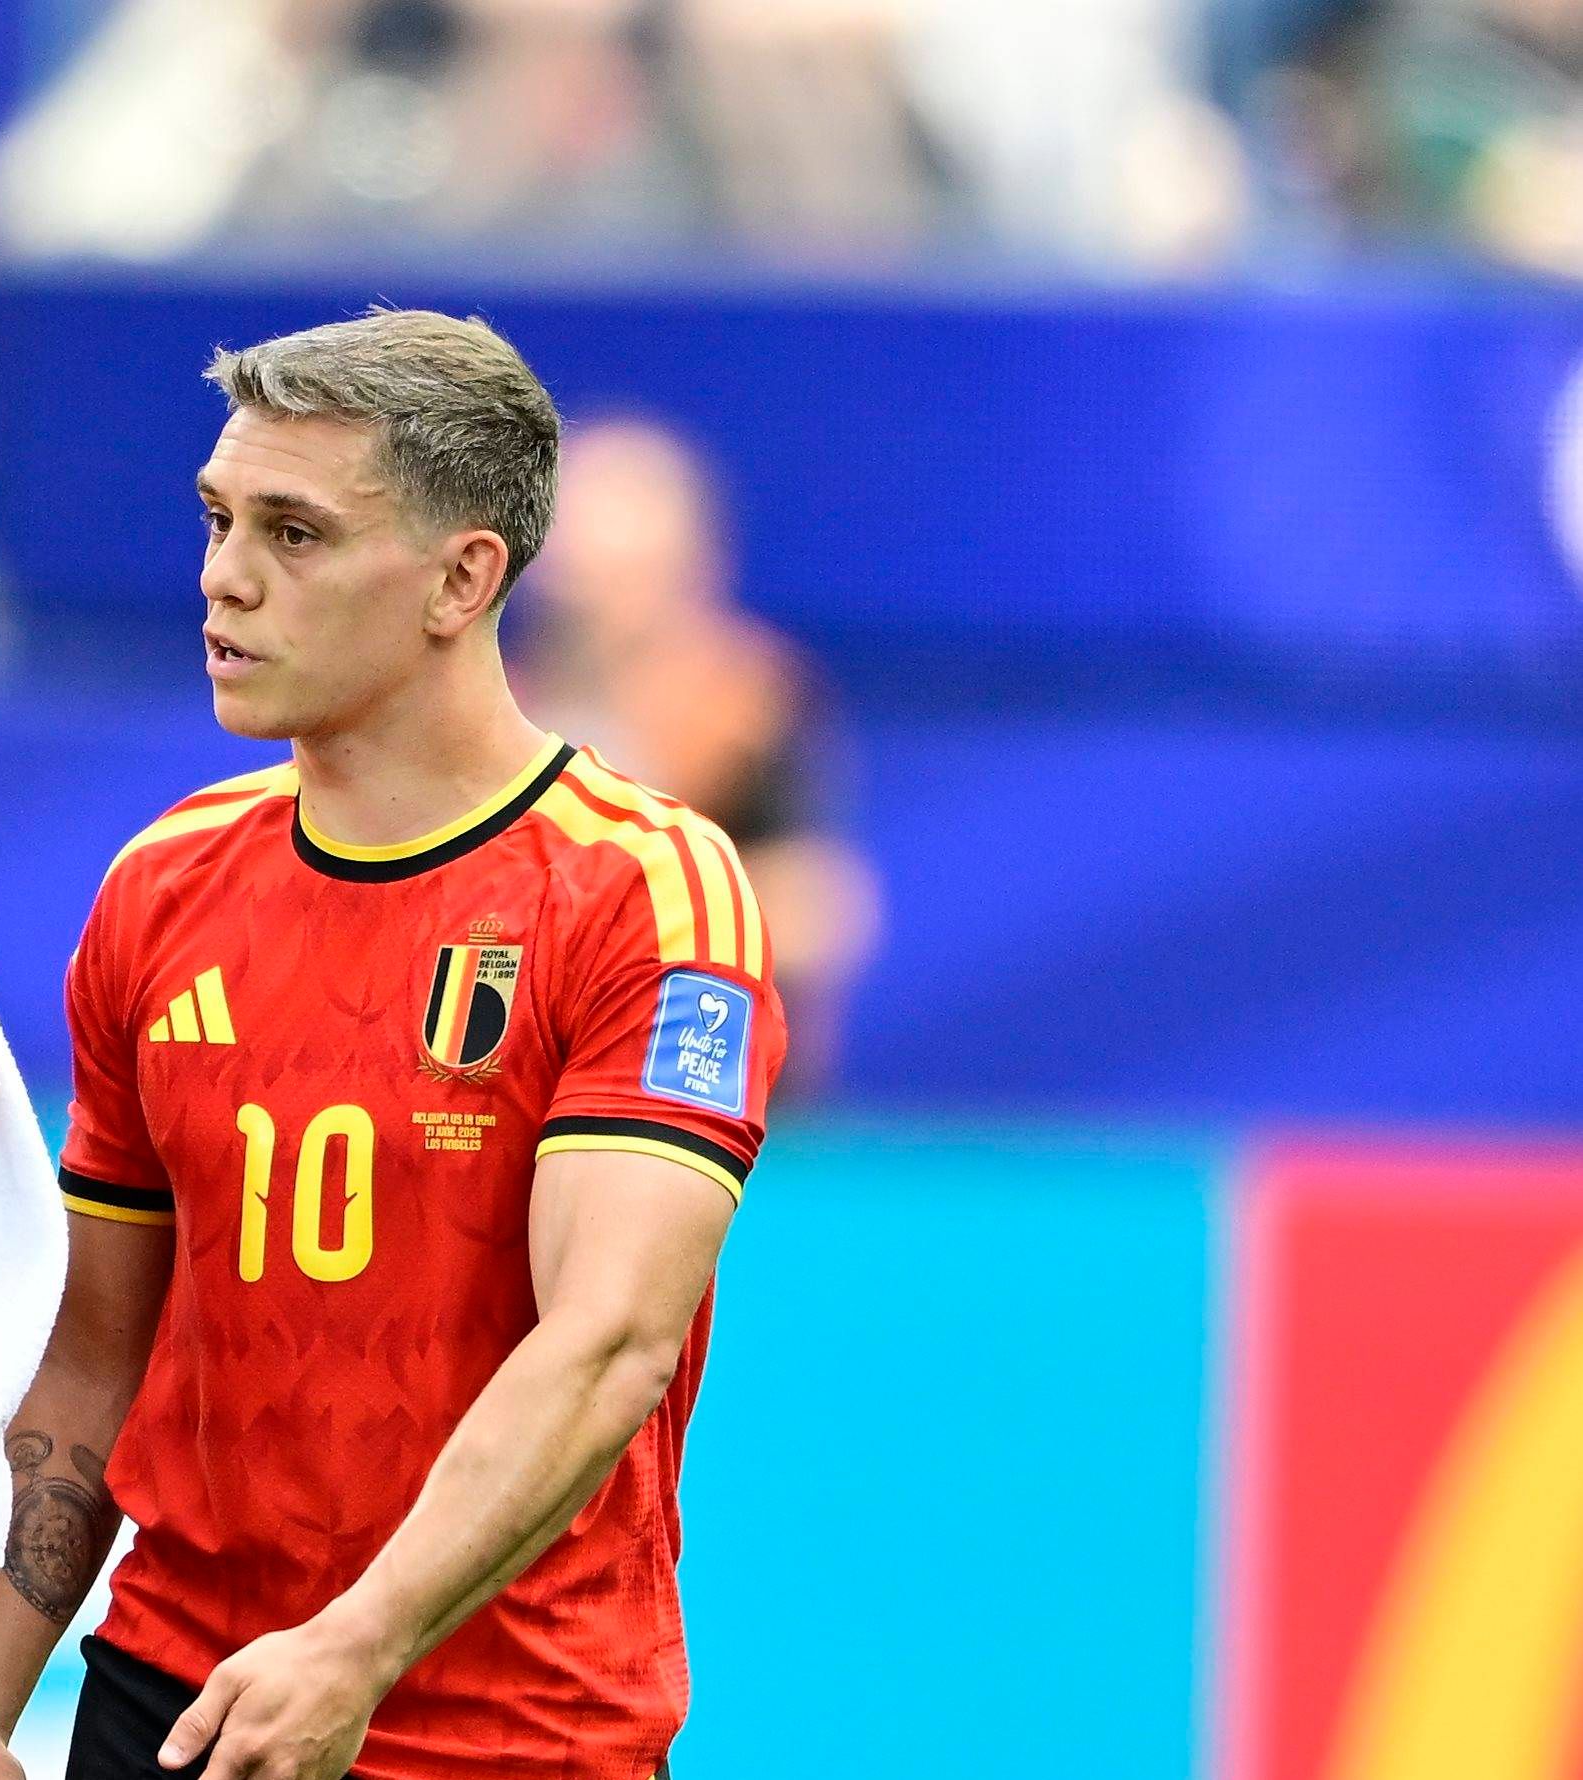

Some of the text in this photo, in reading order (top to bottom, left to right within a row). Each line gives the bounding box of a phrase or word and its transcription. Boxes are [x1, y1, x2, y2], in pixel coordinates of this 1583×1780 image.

[481, 950, 509, 959] ROYAL
[479, 960, 517, 969] BELGIAN
[677, 1026, 713, 1054] Unite
[676, 1050, 722, 1085] PEACE
[683, 1076, 711, 1095] FIFA
[458, 1127, 482, 1138] 2026
[425, 1138, 482, 1151] LOS ANGELES
[236, 1102, 375, 1283] 10
